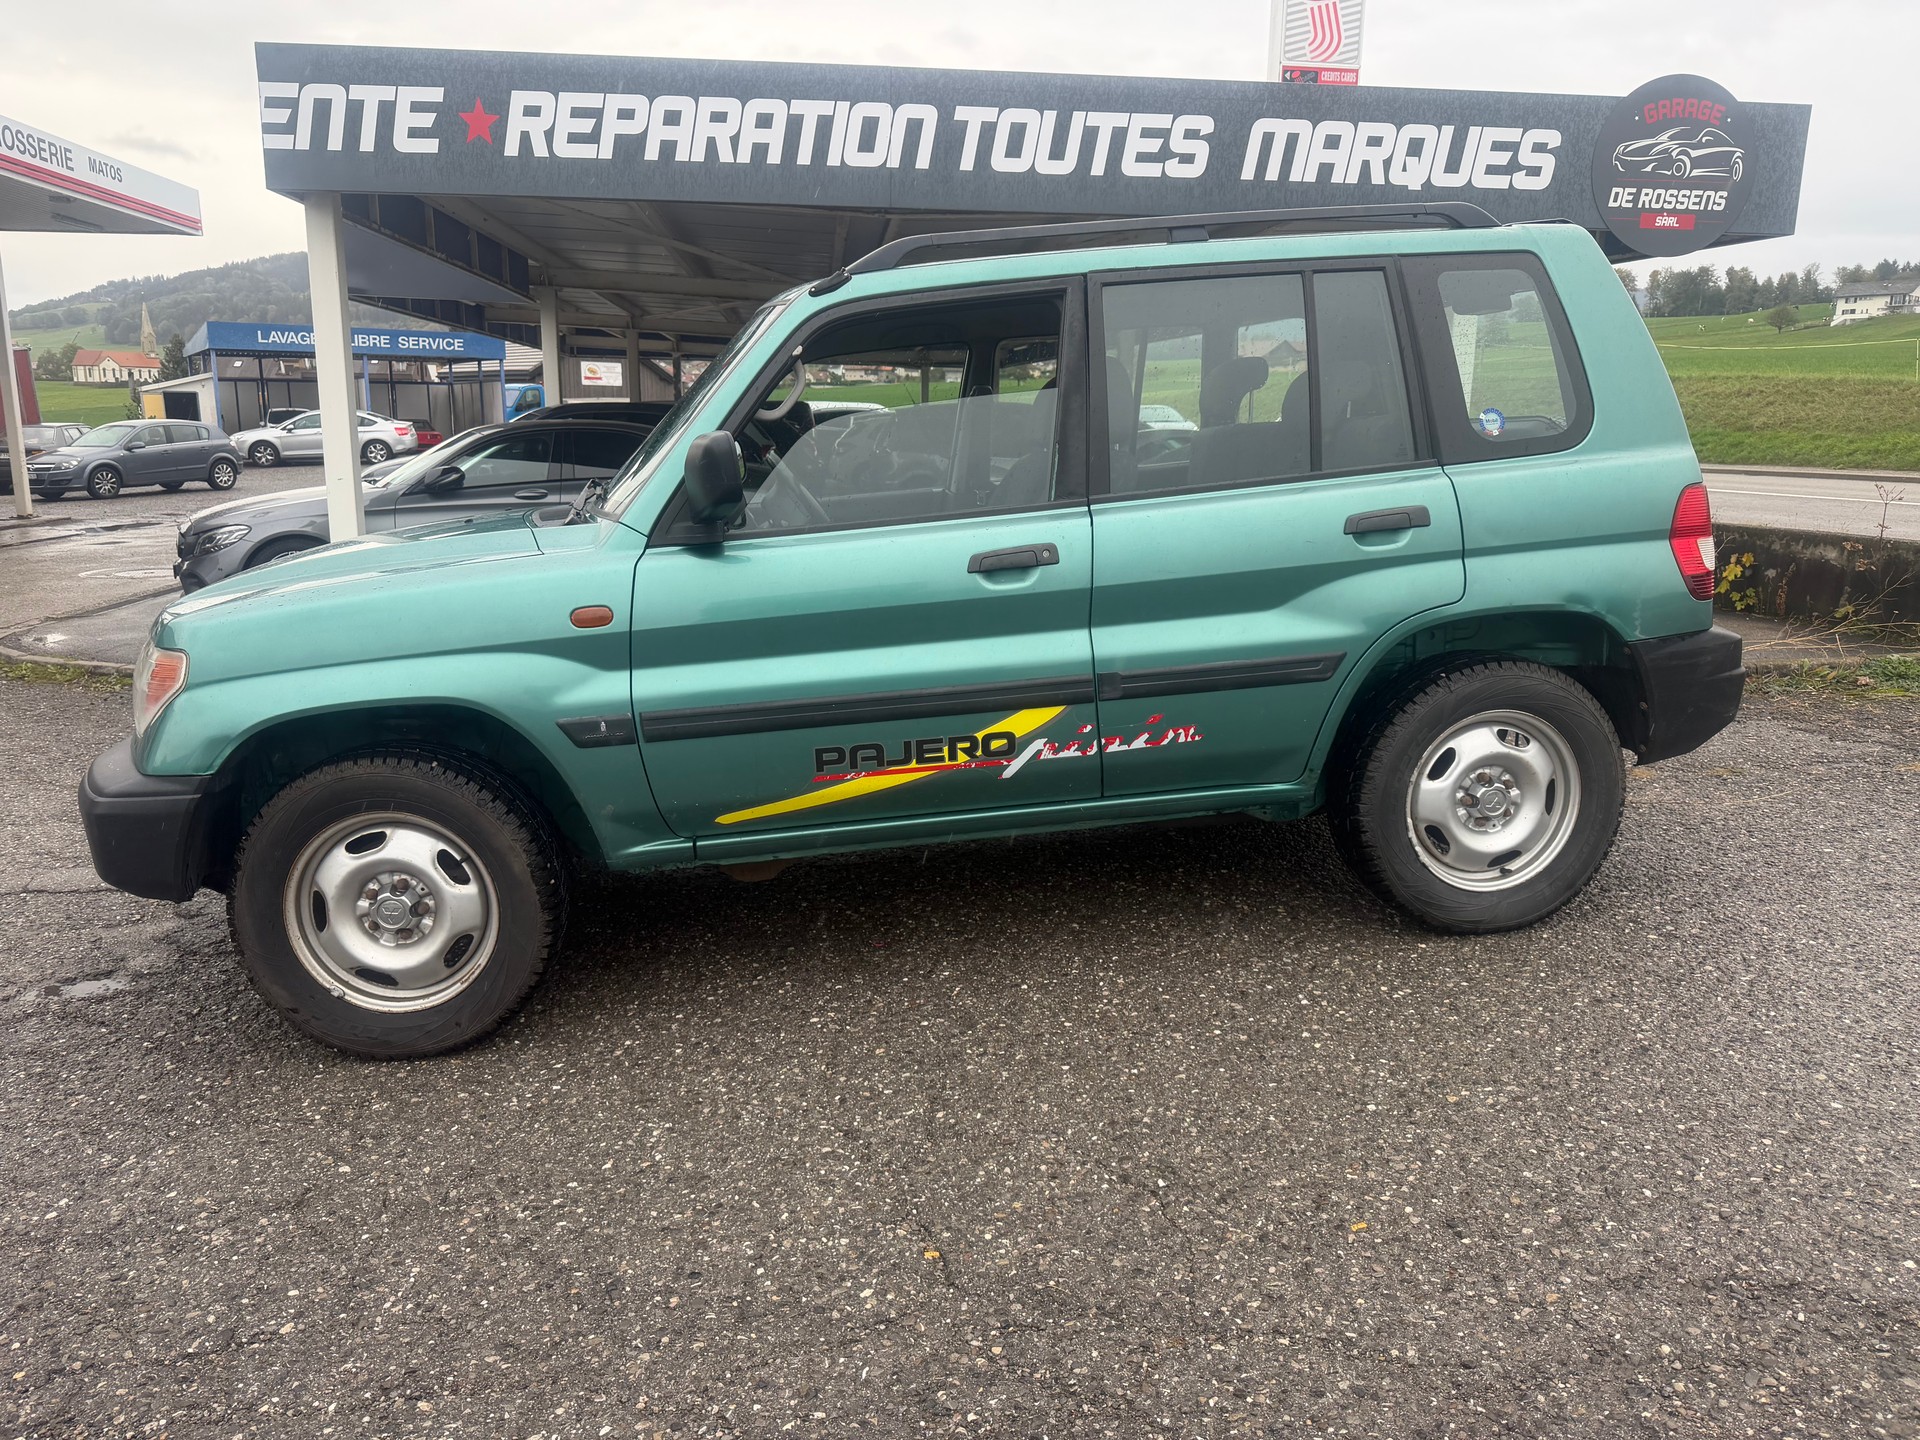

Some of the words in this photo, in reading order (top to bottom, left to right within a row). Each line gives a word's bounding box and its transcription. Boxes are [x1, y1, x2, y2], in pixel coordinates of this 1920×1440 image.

[1321, 71, 1341, 82] CREDITS
[1341, 72, 1357, 83] CARDS
[1643, 98, 1726, 126] GARAGE
[259, 82, 445, 153] ENTE
[504, 90, 938, 169] REPARATION
[954, 105, 1215, 178] TOUTES
[1240, 117, 1562, 191] MARQUES
[0, 124, 75, 172] OSSERIE
[87, 156, 123, 183] MATOS
[1608, 187, 1637, 208] DE
[1638, 188, 1728, 211] ROSSENS
[351, 334, 391, 348] IBRE
[397, 336, 464, 351] SERVICE
[814, 731, 1017, 773] PAJERO
